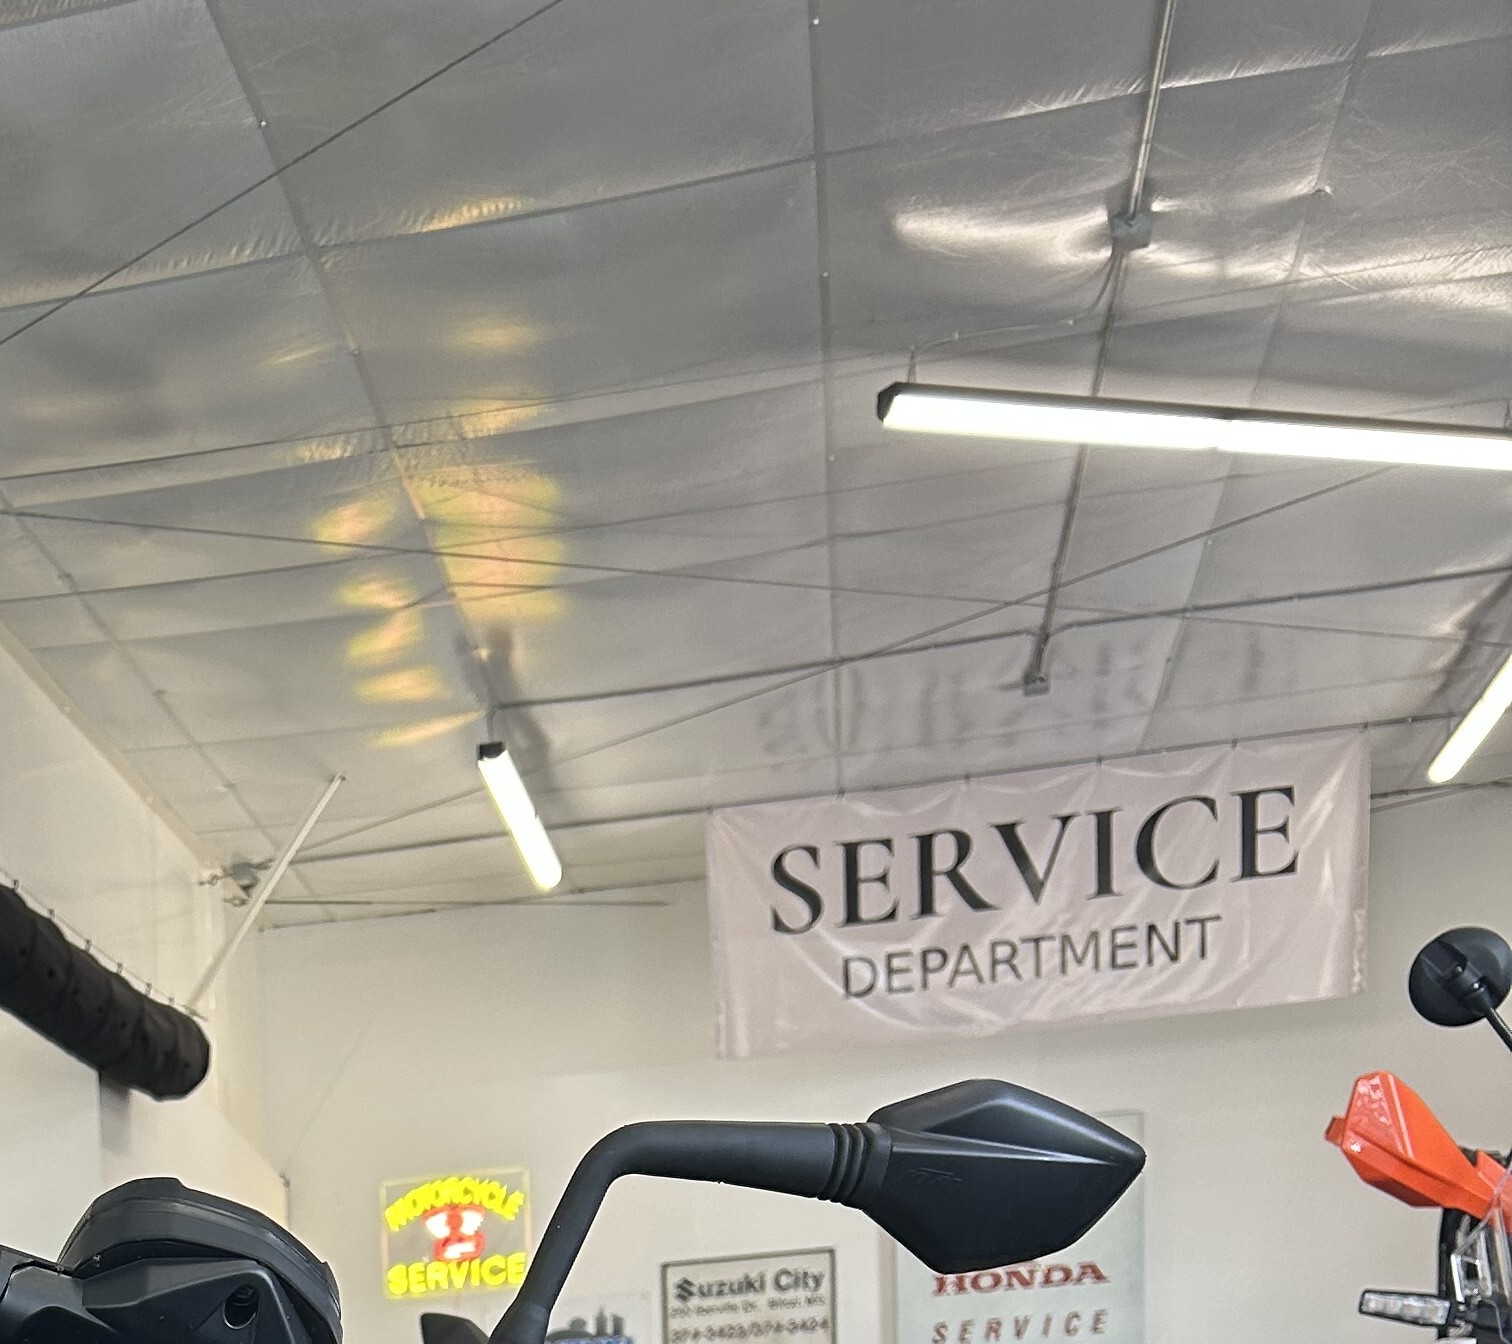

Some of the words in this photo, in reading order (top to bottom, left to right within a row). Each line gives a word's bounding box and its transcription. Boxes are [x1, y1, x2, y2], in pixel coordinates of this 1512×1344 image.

[769, 785, 1299, 936] SERVICE
[841, 915, 1222, 1000] DEPARTMENT
[384, 1176, 525, 1232] MOTORCYCLE
[387, 1252, 527, 1295] SERVICE
[674, 1271, 766, 1303] Suzuki
[773, 1268, 826, 1292] City
[931, 1260, 1111, 1297] HONDA
